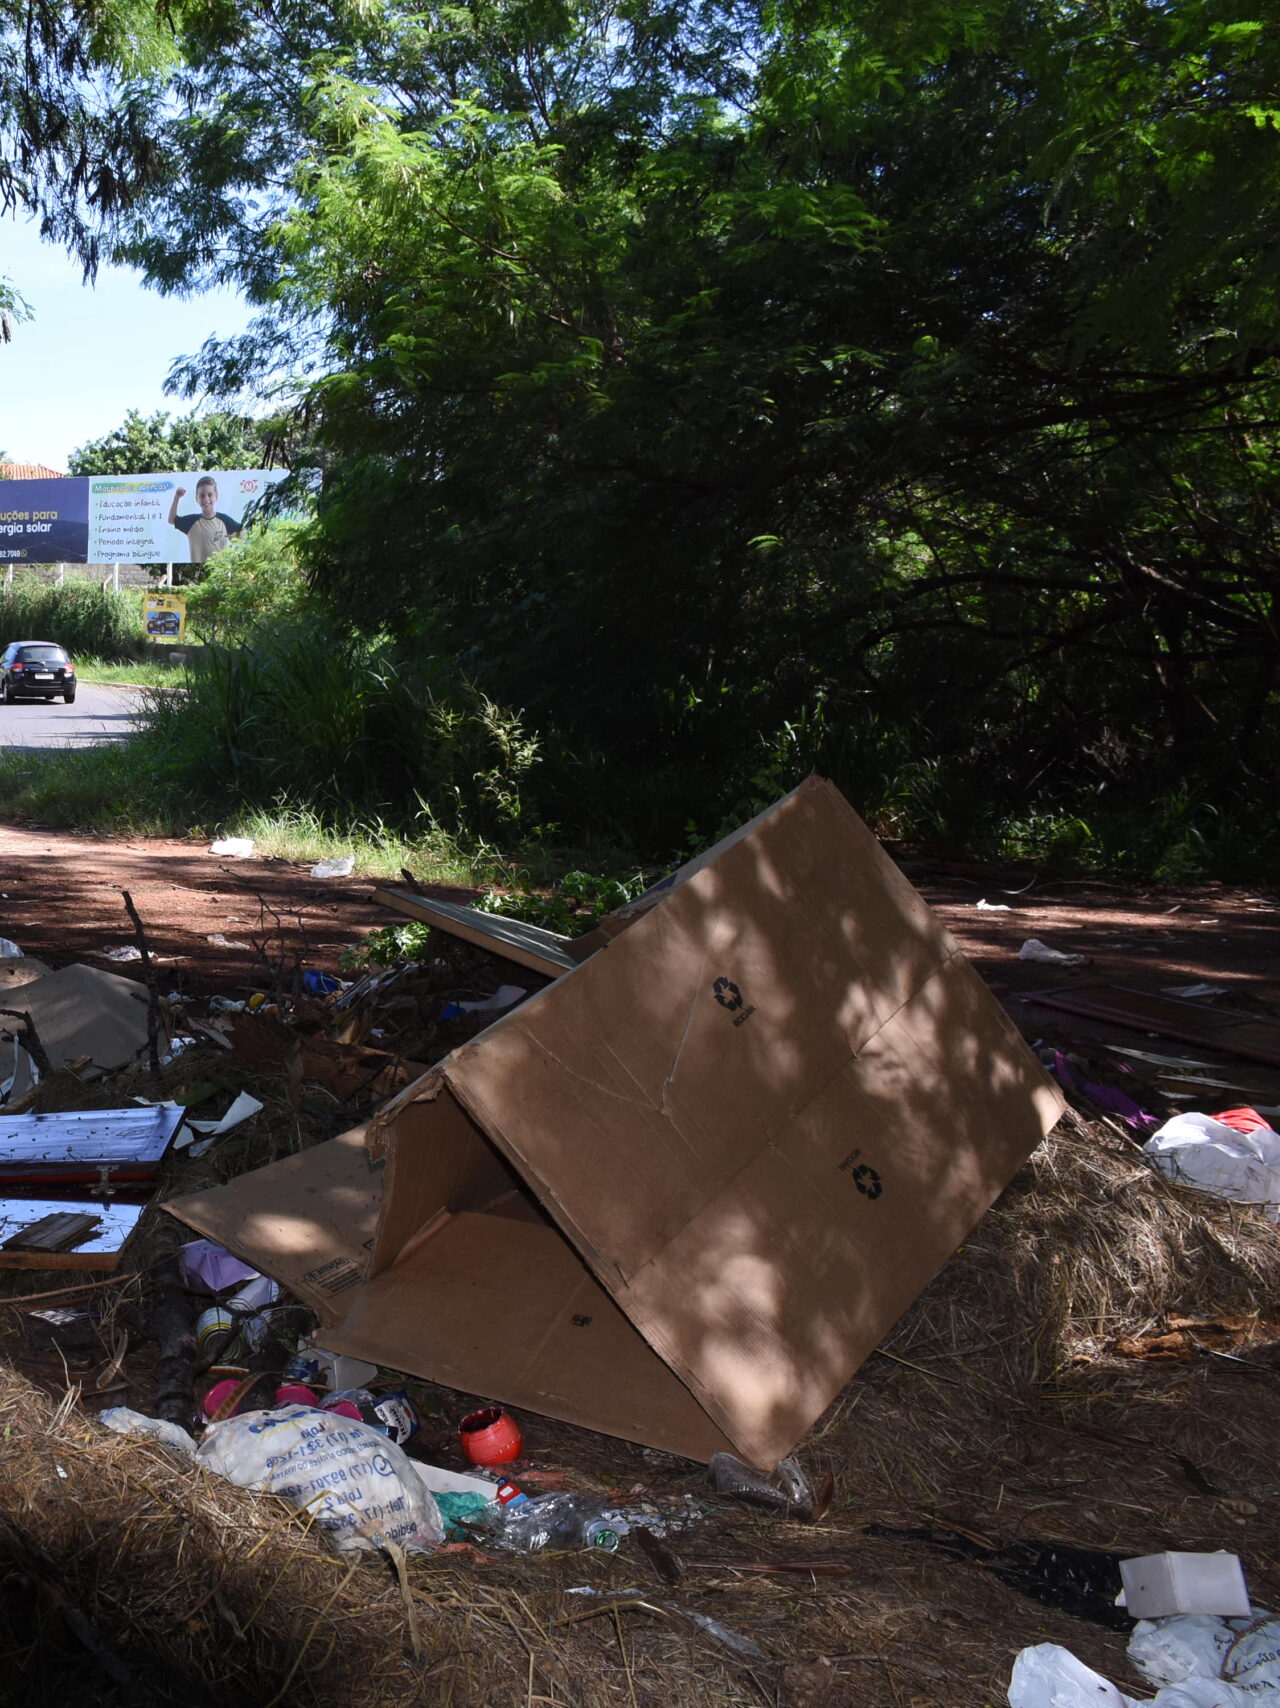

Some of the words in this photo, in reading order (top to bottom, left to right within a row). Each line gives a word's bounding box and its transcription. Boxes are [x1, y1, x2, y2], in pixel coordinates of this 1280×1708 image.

[99, 499, 132, 509] Educação
[134, 498, 161, 507] infantil
[33, 510, 58, 522] para
[98, 513, 146, 521] Fundamental
[26, 522, 52, 533] solar
[98, 525, 121, 533] Ensino
[125, 538, 155, 547] integral
[97, 550, 130, 559] Programa
